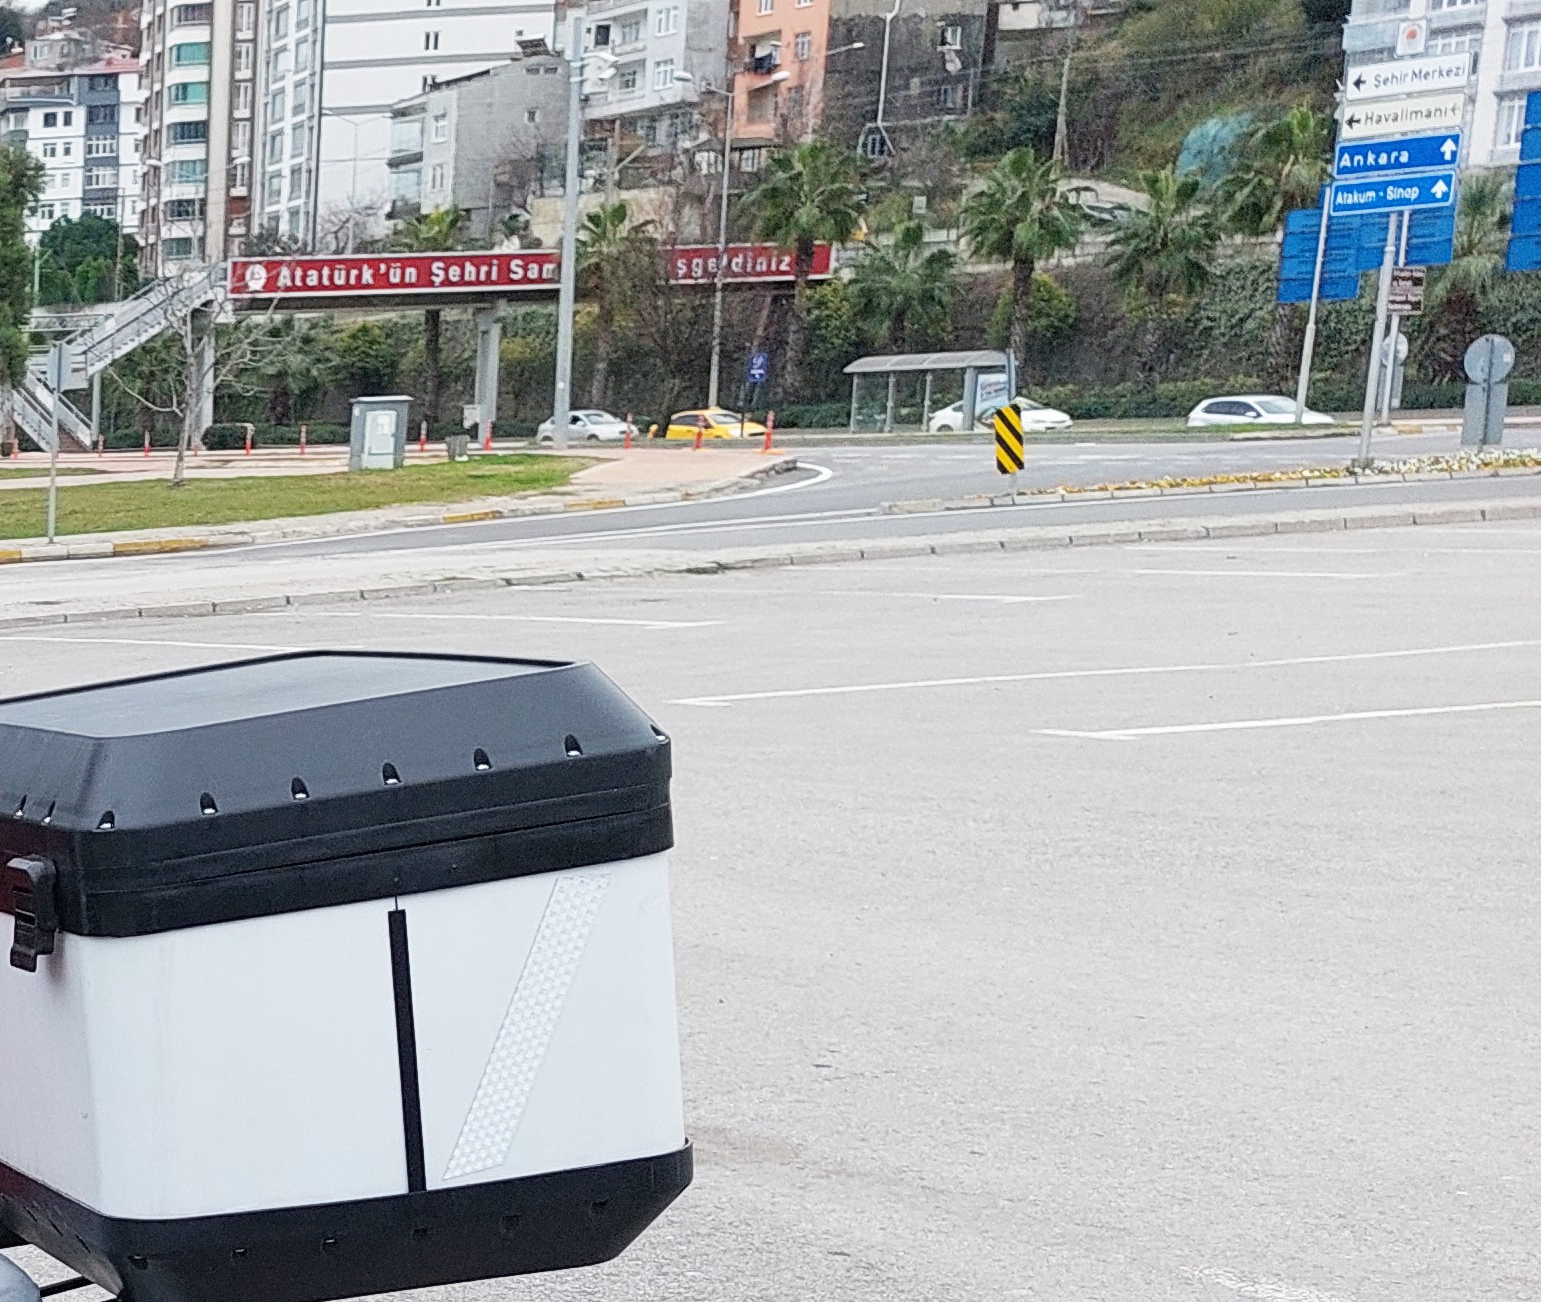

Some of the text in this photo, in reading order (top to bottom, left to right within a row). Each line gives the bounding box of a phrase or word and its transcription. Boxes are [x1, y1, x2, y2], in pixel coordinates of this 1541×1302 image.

[1339, 149, 1410, 169] Ankara
[1336, 188, 1377, 206] Atakum
[1386, 185, 1420, 202] Sinop
[277, 262, 417, 288] Atatürk'ün
[431, 258, 499, 287] Şehri
